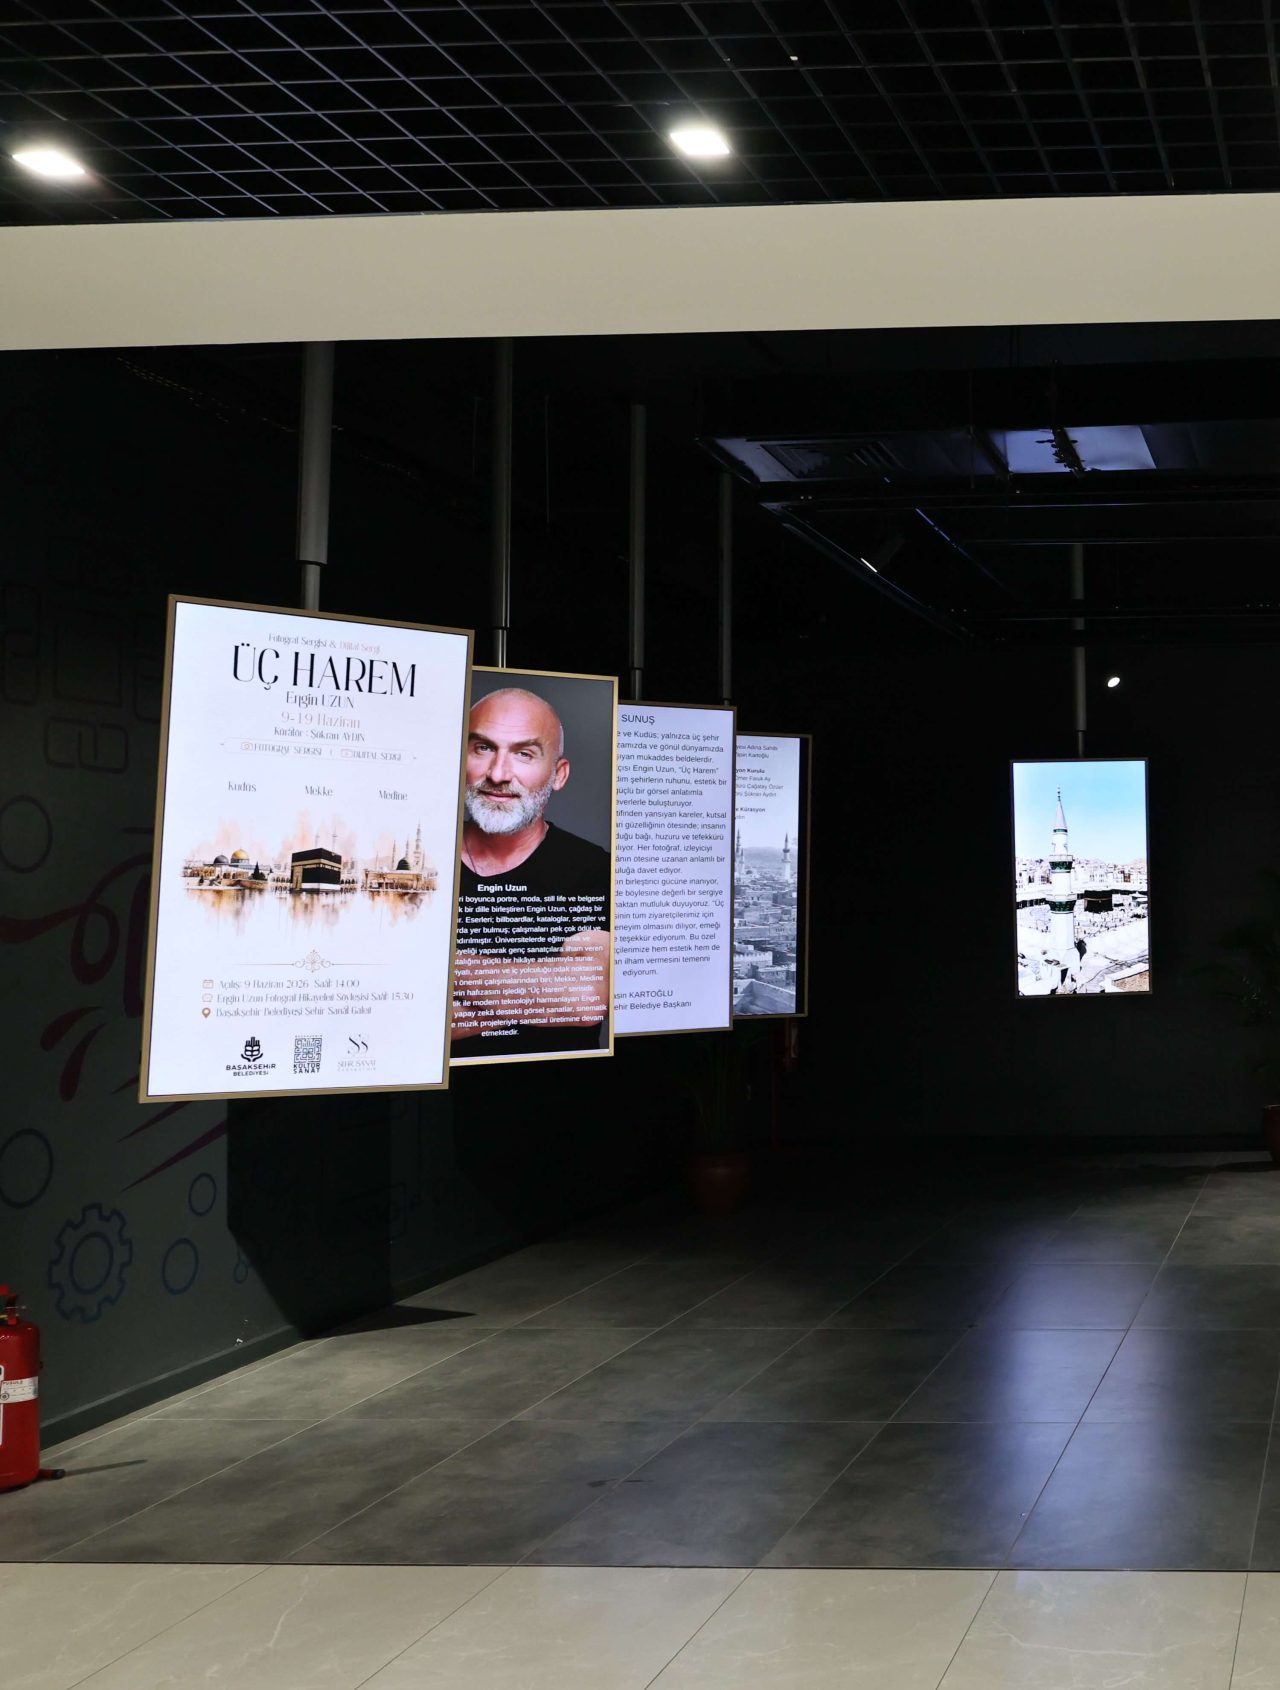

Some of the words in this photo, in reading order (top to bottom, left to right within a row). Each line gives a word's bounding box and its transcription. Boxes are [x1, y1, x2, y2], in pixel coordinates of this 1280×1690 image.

[233, 642, 279, 690] ÜÇ
[292, 652, 416, 697] HAREM
[286, 691, 317, 709] Engin
[322, 694, 354, 709] UZUN
[317, 713, 360, 729] Haziran
[621, 715, 655, 725] SUNUŞ
[661, 732, 690, 741] yalnızca
[660, 743, 679, 751] gönül
[682, 745, 723, 753] dünyamızda
[633, 765, 653, 773] Engin
[305, 786, 333, 796] Mekke
[378, 790, 408, 800] Medine
[647, 788, 669, 796] görsel
[662, 878, 687, 886] gücüne
[478, 884, 502, 893] Engin
[662, 889, 685, 897] değerli
[491, 906, 524, 914] birleştiren
[569, 905, 592, 913] çağdaş
[512, 926, 548, 934] çalışmaları
[509, 947, 525, 955] genç
[527, 946, 564, 954] sanatçılara
[625, 957, 644, 965] ilham
[254, 980, 283, 988] Haziran
[286, 980, 308, 988] 2026
[485, 977, 538, 985] çalışmalarından
[629, 989, 673, 998] KARTOĞLU
[502, 997, 535, 1005] teknolojiyi
[537, 996, 579, 1004] harmanlayan
[630, 1002, 660, 1010] Belediye
[524, 1007, 544, 1015] görsel
[480, 1019, 517, 1027] projeleriyle
[481, 1029, 519, 1037] etmektedir.
